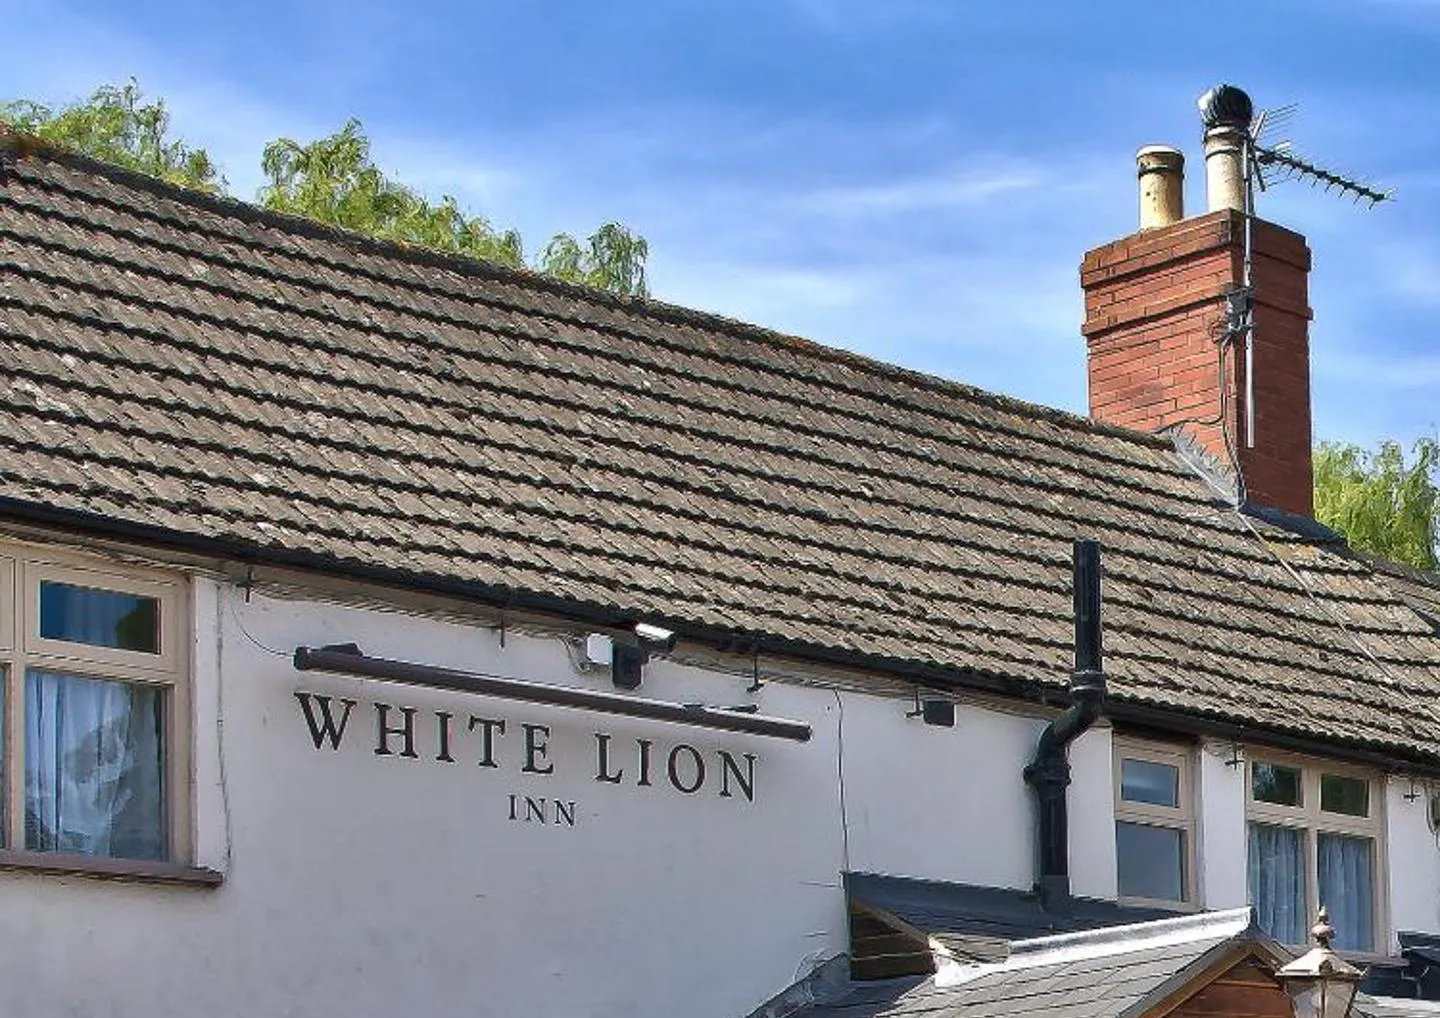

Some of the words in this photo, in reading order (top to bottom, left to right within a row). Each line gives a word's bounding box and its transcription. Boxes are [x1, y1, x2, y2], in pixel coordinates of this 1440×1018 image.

[294, 693, 554, 775] WHITE
[594, 732, 758, 801] LION
[507, 794, 576, 826] INN
